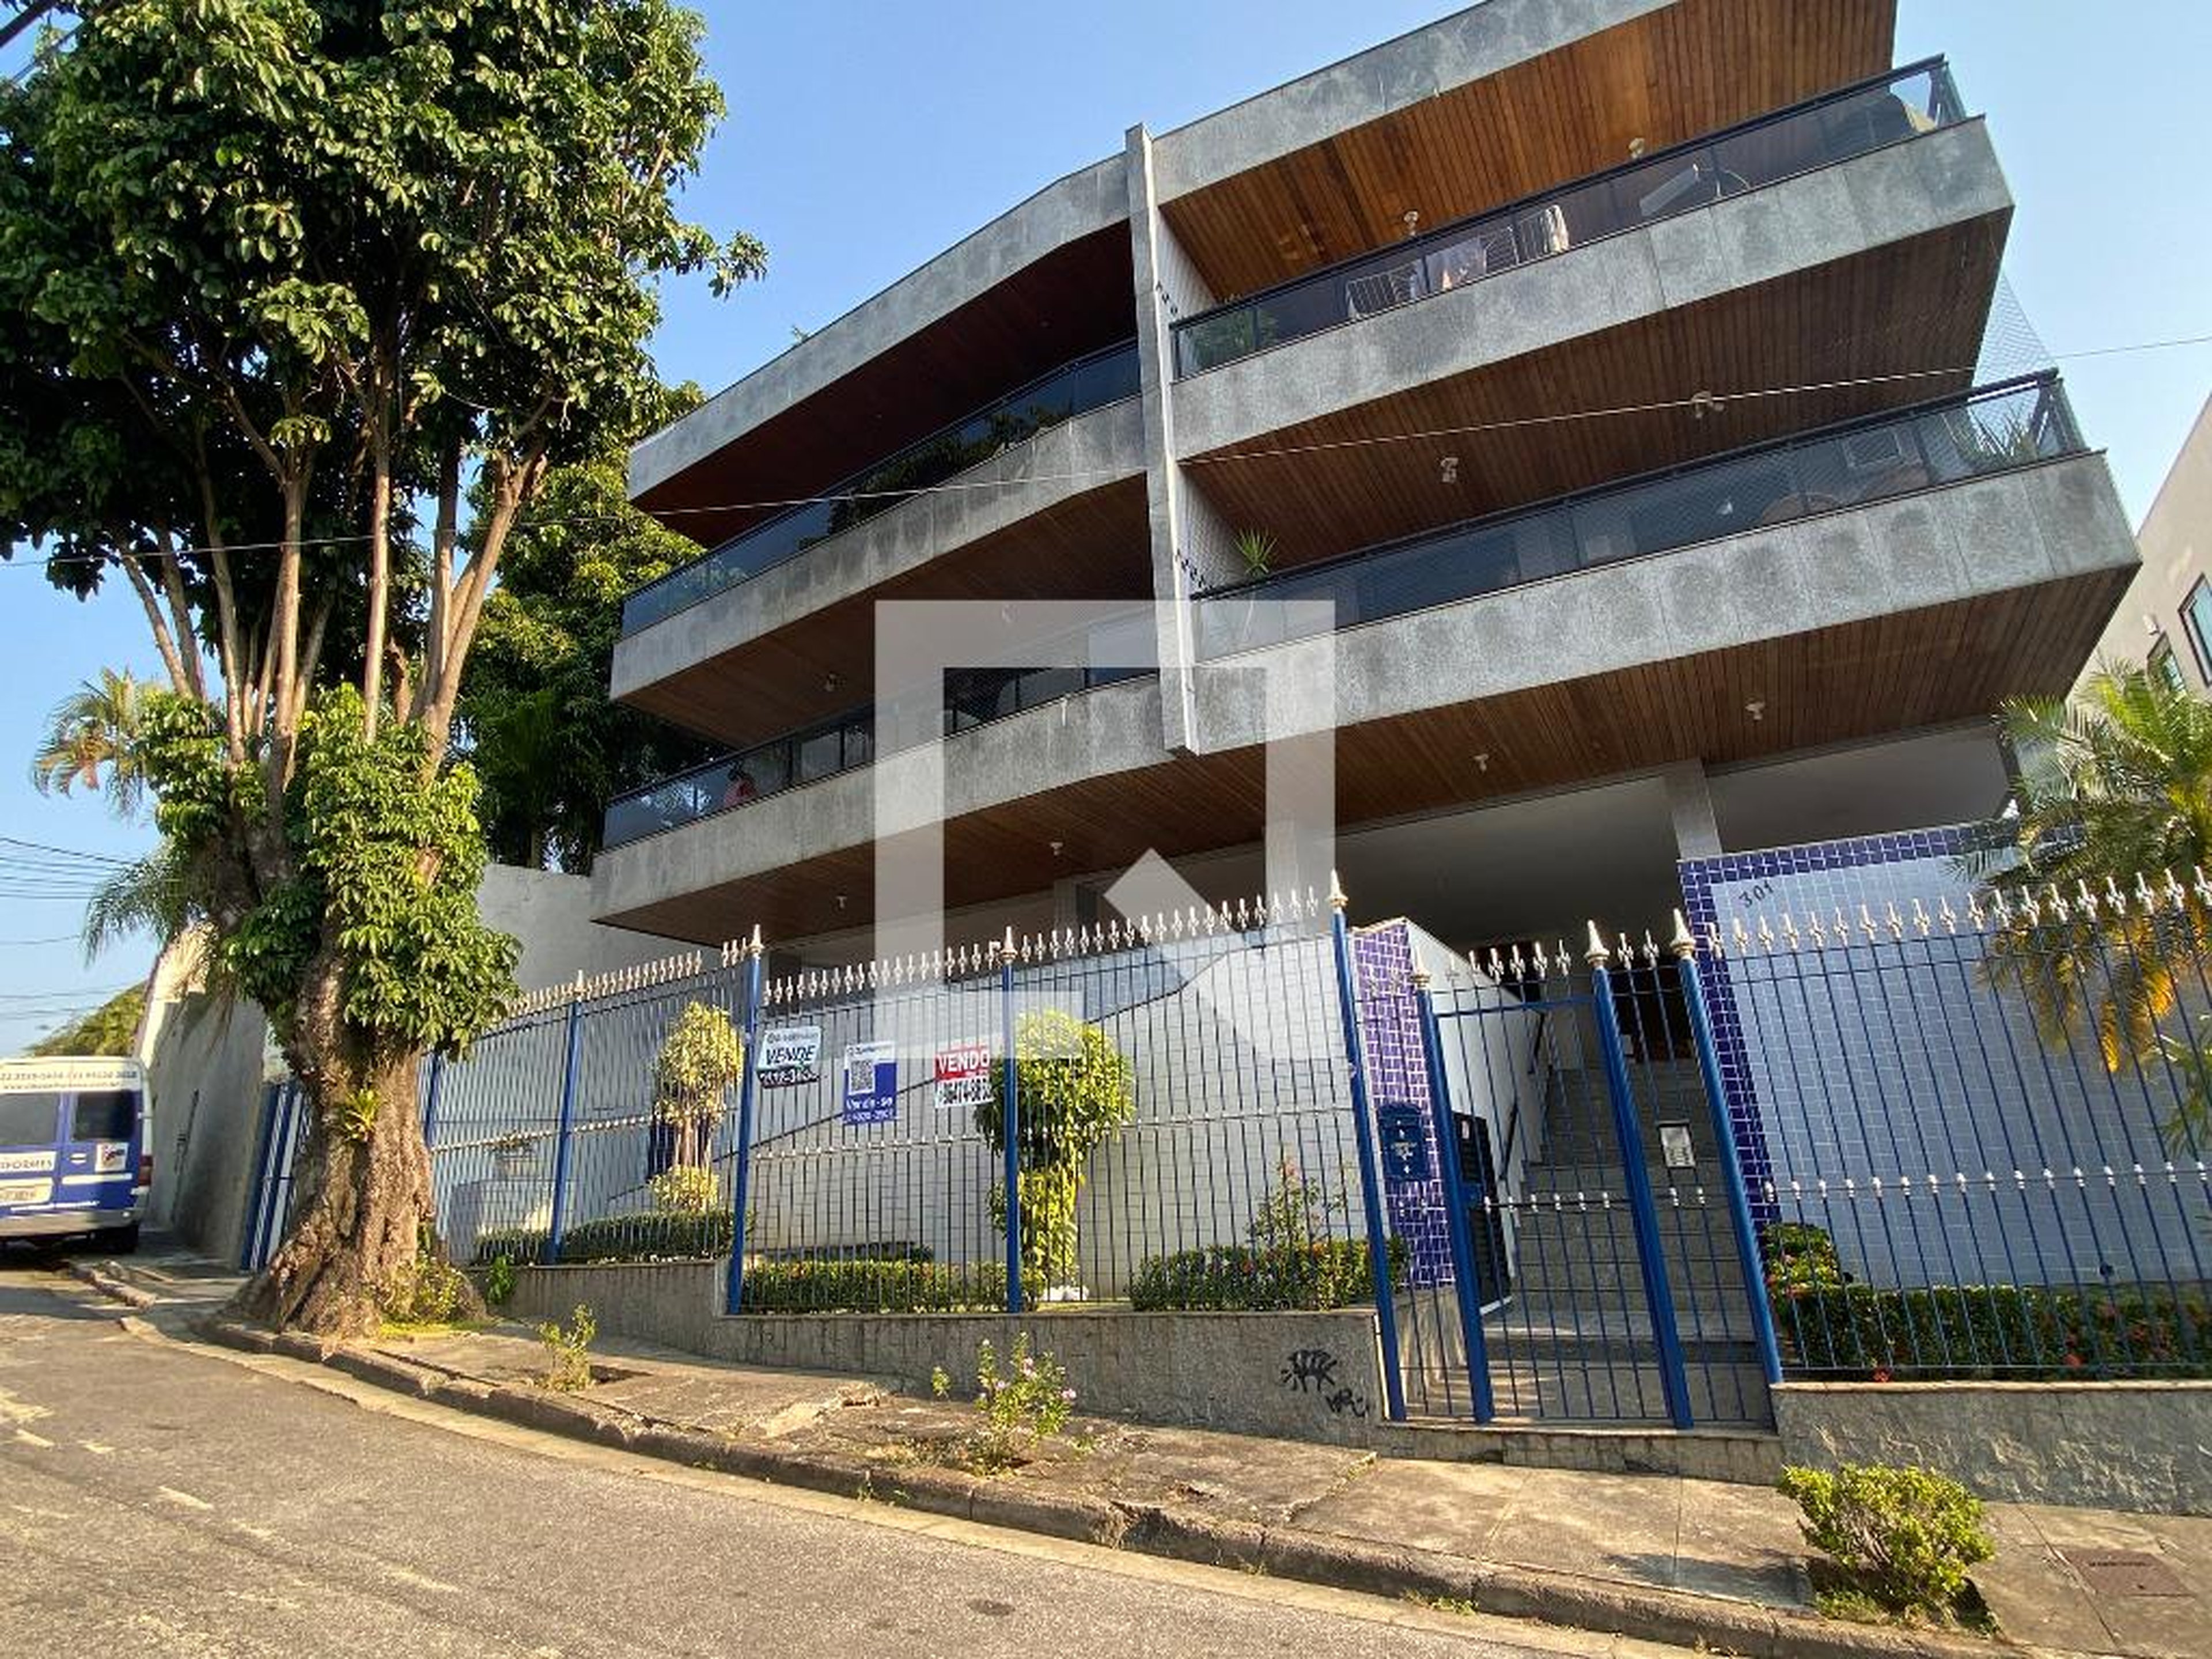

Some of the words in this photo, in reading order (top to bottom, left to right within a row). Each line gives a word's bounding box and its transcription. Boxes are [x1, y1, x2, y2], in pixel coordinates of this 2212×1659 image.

[1738, 880, 1775, 908] 301
[766, 1044, 816, 1065] VENDE
[937, 1050, 990, 1074] VENDO
